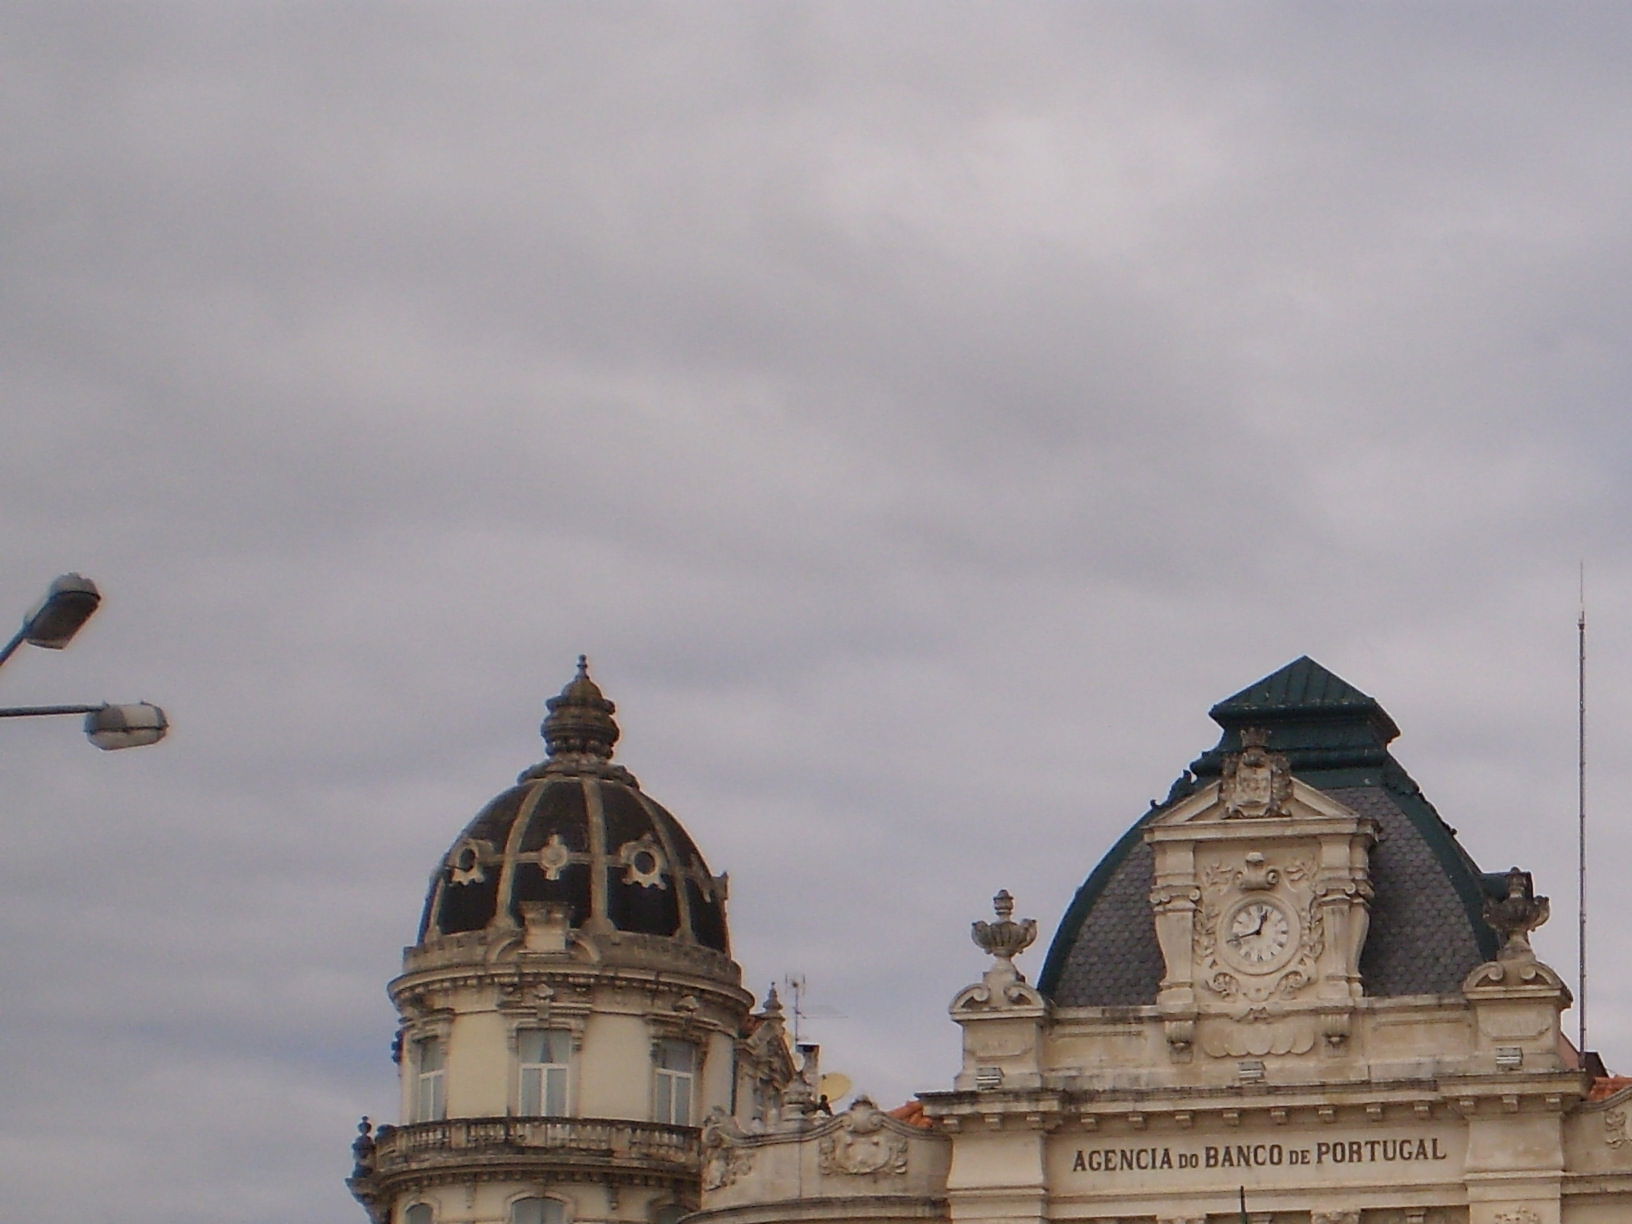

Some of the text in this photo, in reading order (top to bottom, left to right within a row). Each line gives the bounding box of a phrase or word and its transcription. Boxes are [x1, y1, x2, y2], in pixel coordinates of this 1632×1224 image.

[1073, 1138, 1447, 1172] AGENCIA DO BANCO DE PORTUGAL
